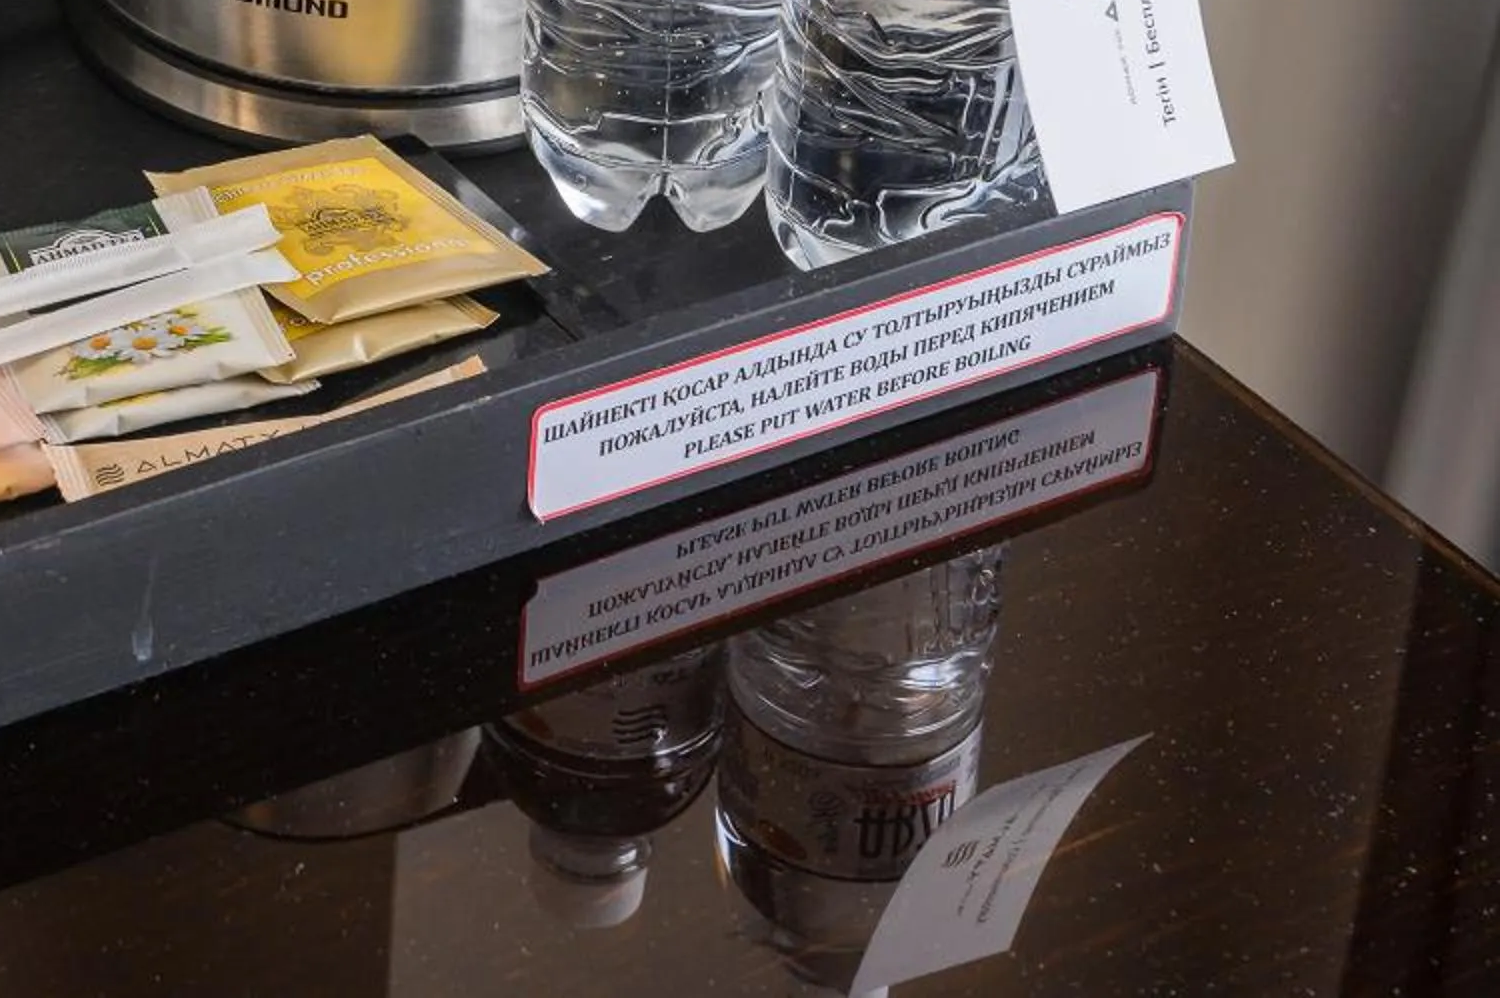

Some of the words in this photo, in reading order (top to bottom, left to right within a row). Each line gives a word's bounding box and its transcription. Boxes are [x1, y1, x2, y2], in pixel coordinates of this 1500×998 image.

[1153, 75, 1177, 127] Тегін
[543, 394, 657, 444] ШАЙНЕКТІ
[662, 372, 730, 408] ҚОСАР
[733, 338, 838, 385] АЛДЫНДА
[842, 327, 869, 350] СУ
[872, 267, 1062, 340] ТОЛТЫРУЫҢЫЗДЫ
[1066, 232, 1173, 280] СҰРАЙМЫЗ
[598, 400, 746, 457] ПОЖАЛУЙСТА,
[750, 365, 846, 409] НАЛЕЙТЕ
[850, 344, 909, 379] ВОДЫ
[913, 324, 976, 358] ПЕРЕД
[980, 279, 1116, 337] КИПЯЧЕНИЕМ
[683, 423, 757, 459] PLEASE
[760, 407, 801, 435] PUT
[804, 386, 872, 420] WATER
[875, 359, 951, 395] BEFORE
[954, 335, 1032, 372] BOILING
[137, 429, 280, 474] ALMATY
